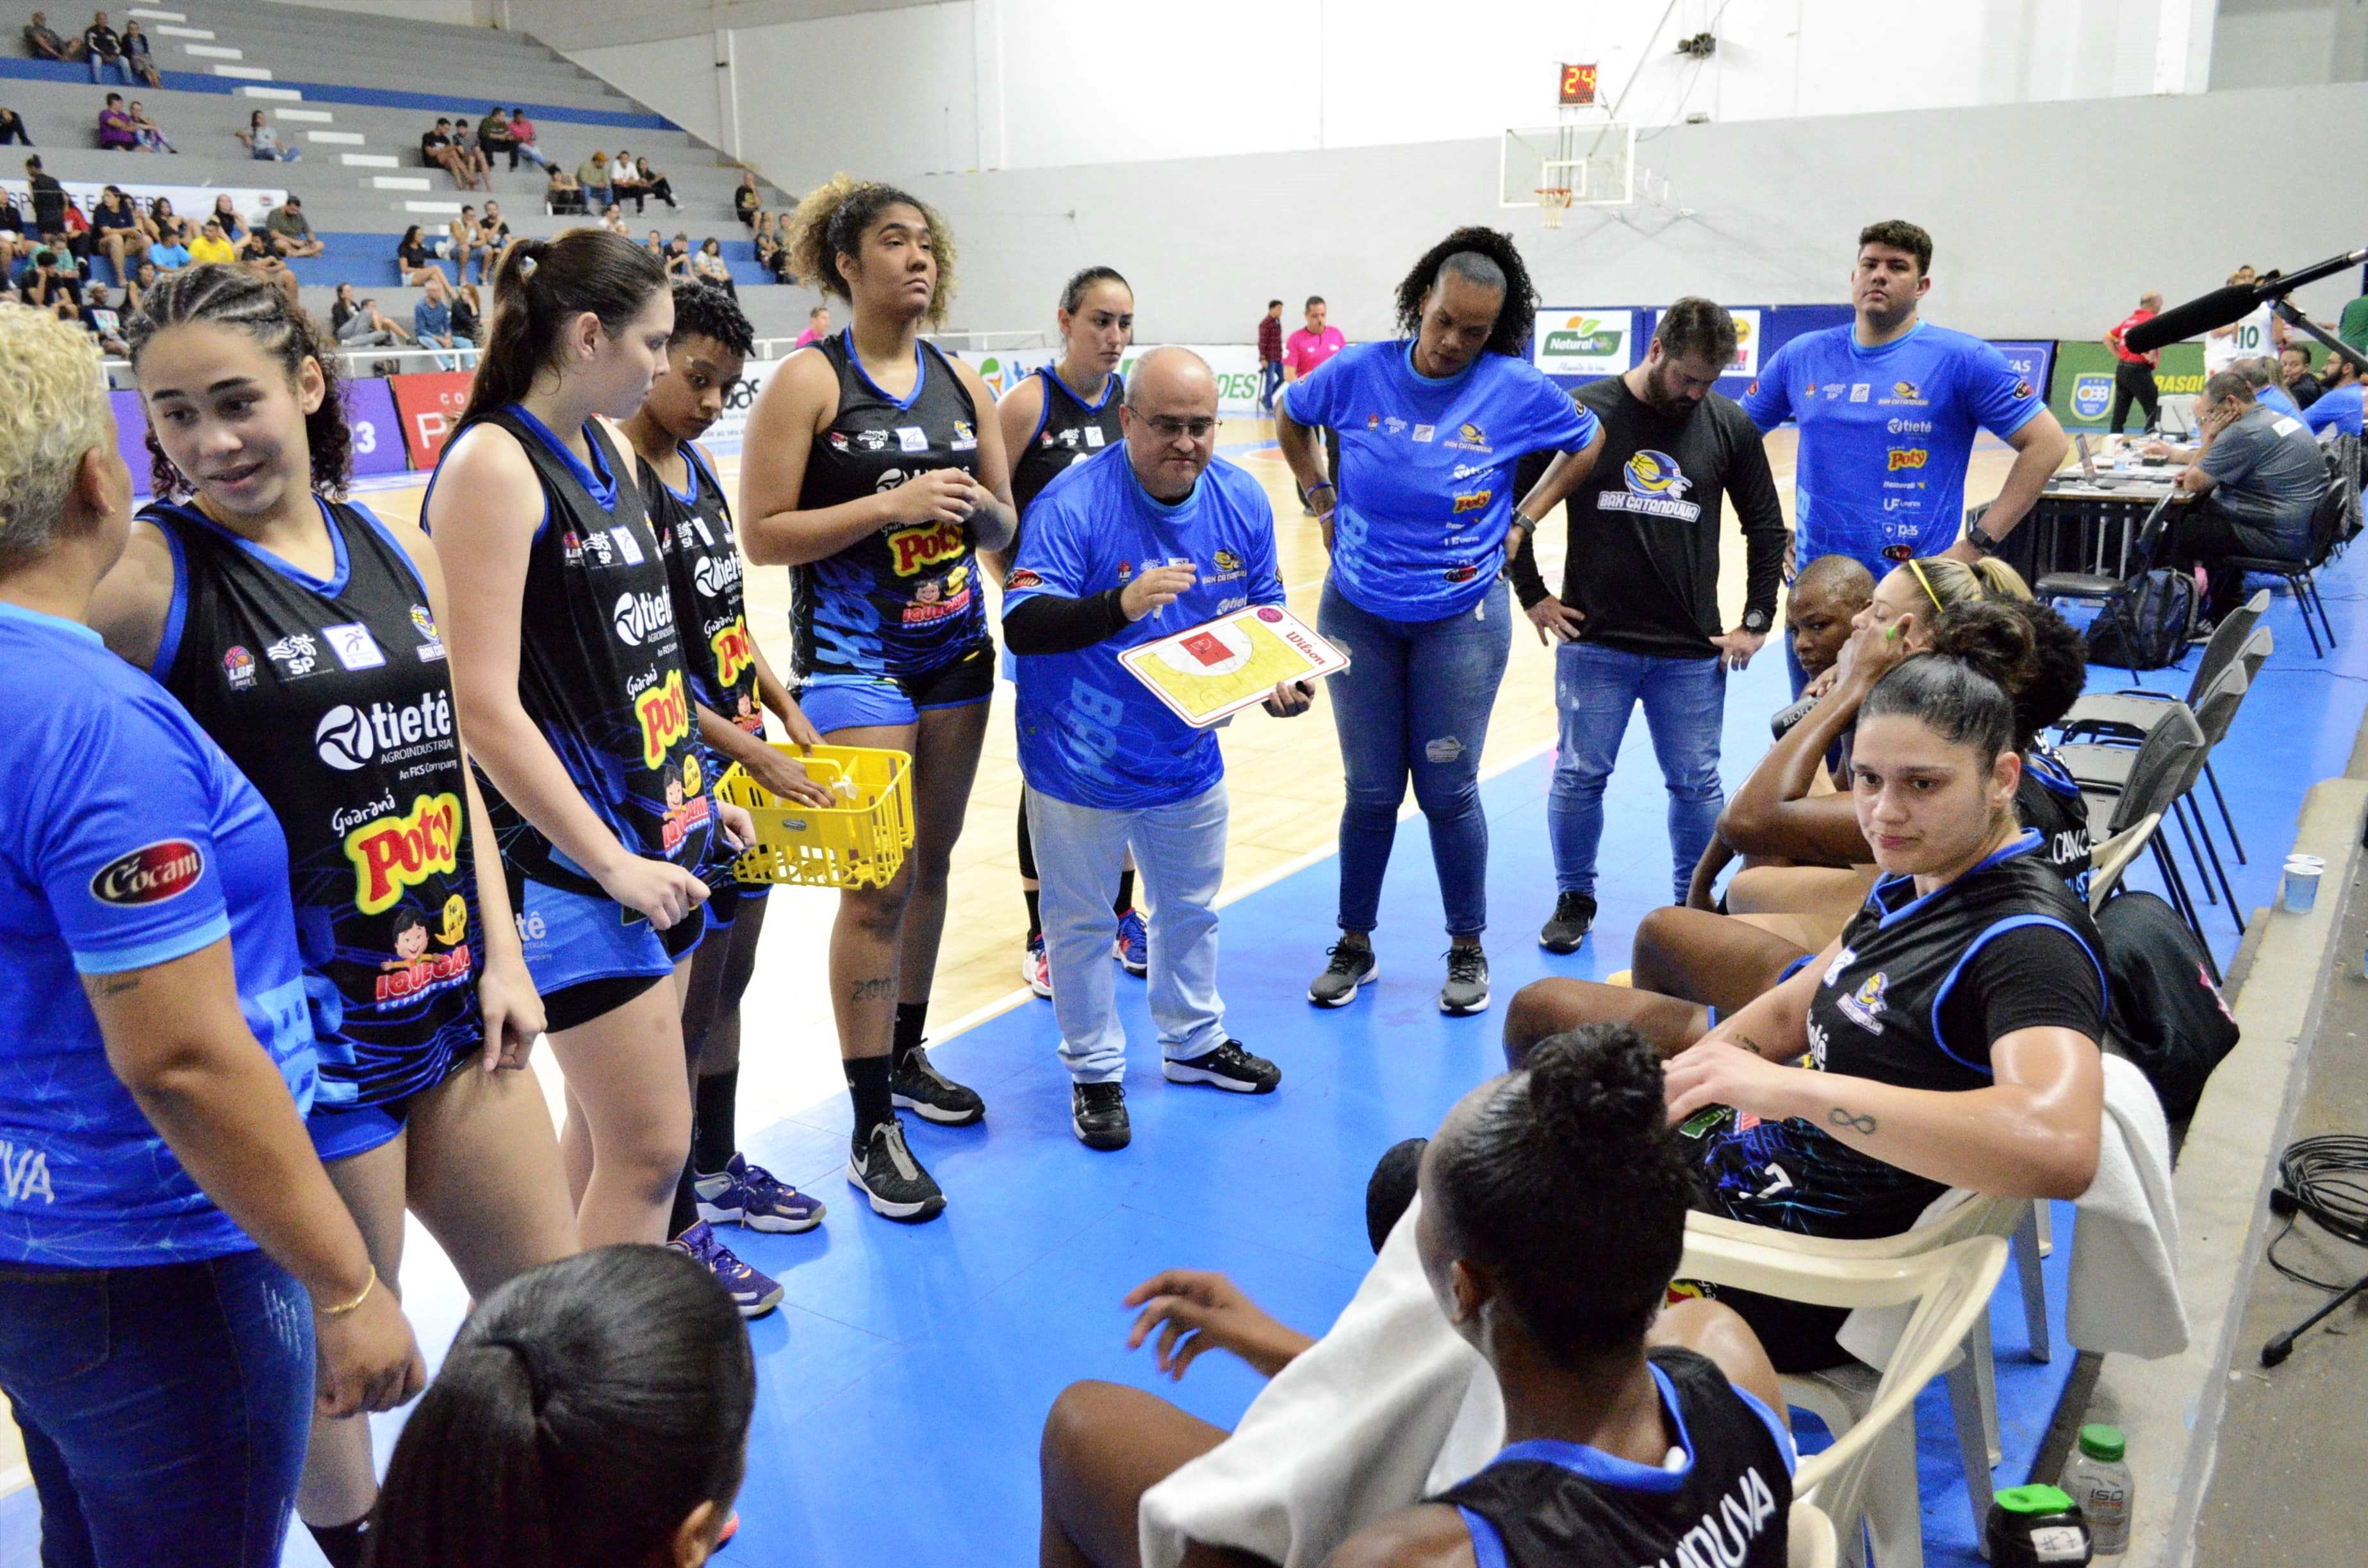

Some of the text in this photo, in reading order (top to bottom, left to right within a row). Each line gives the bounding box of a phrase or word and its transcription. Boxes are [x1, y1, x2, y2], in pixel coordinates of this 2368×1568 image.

[1564, 67, 1596, 94] 24
[1550, 337, 1593, 350] Natural
[2239, 325, 2259, 349] 10
[440, 393, 465, 405] CO
[1217, 373, 1257, 399] DES
[354, 421, 377, 453] 3
[416, 412, 447, 448] P
[869, 440, 885, 450] SP
[1599, 493, 1698, 520] BAX CATANDUVA
[1228, 593, 1247, 609] tiet
[718, 621, 749, 679] Pot
[1285, 630, 1326, 666] Wilson
[228, 664, 255, 681] LBF
[289, 657, 315, 675] SP
[372, 689, 451, 749] tietê
[642, 678, 686, 758] Poty
[381, 738, 455, 764] AGROINDUSTRIAL
[400, 758, 457, 781] An FKS Company
[332, 787, 396, 838] Guaraná
[358, 804, 452, 902] Poty
[104, 855, 199, 899] Cocam
[0, 1140, 54, 1204] VA
[2090, 1488, 2124, 1501] ISO
